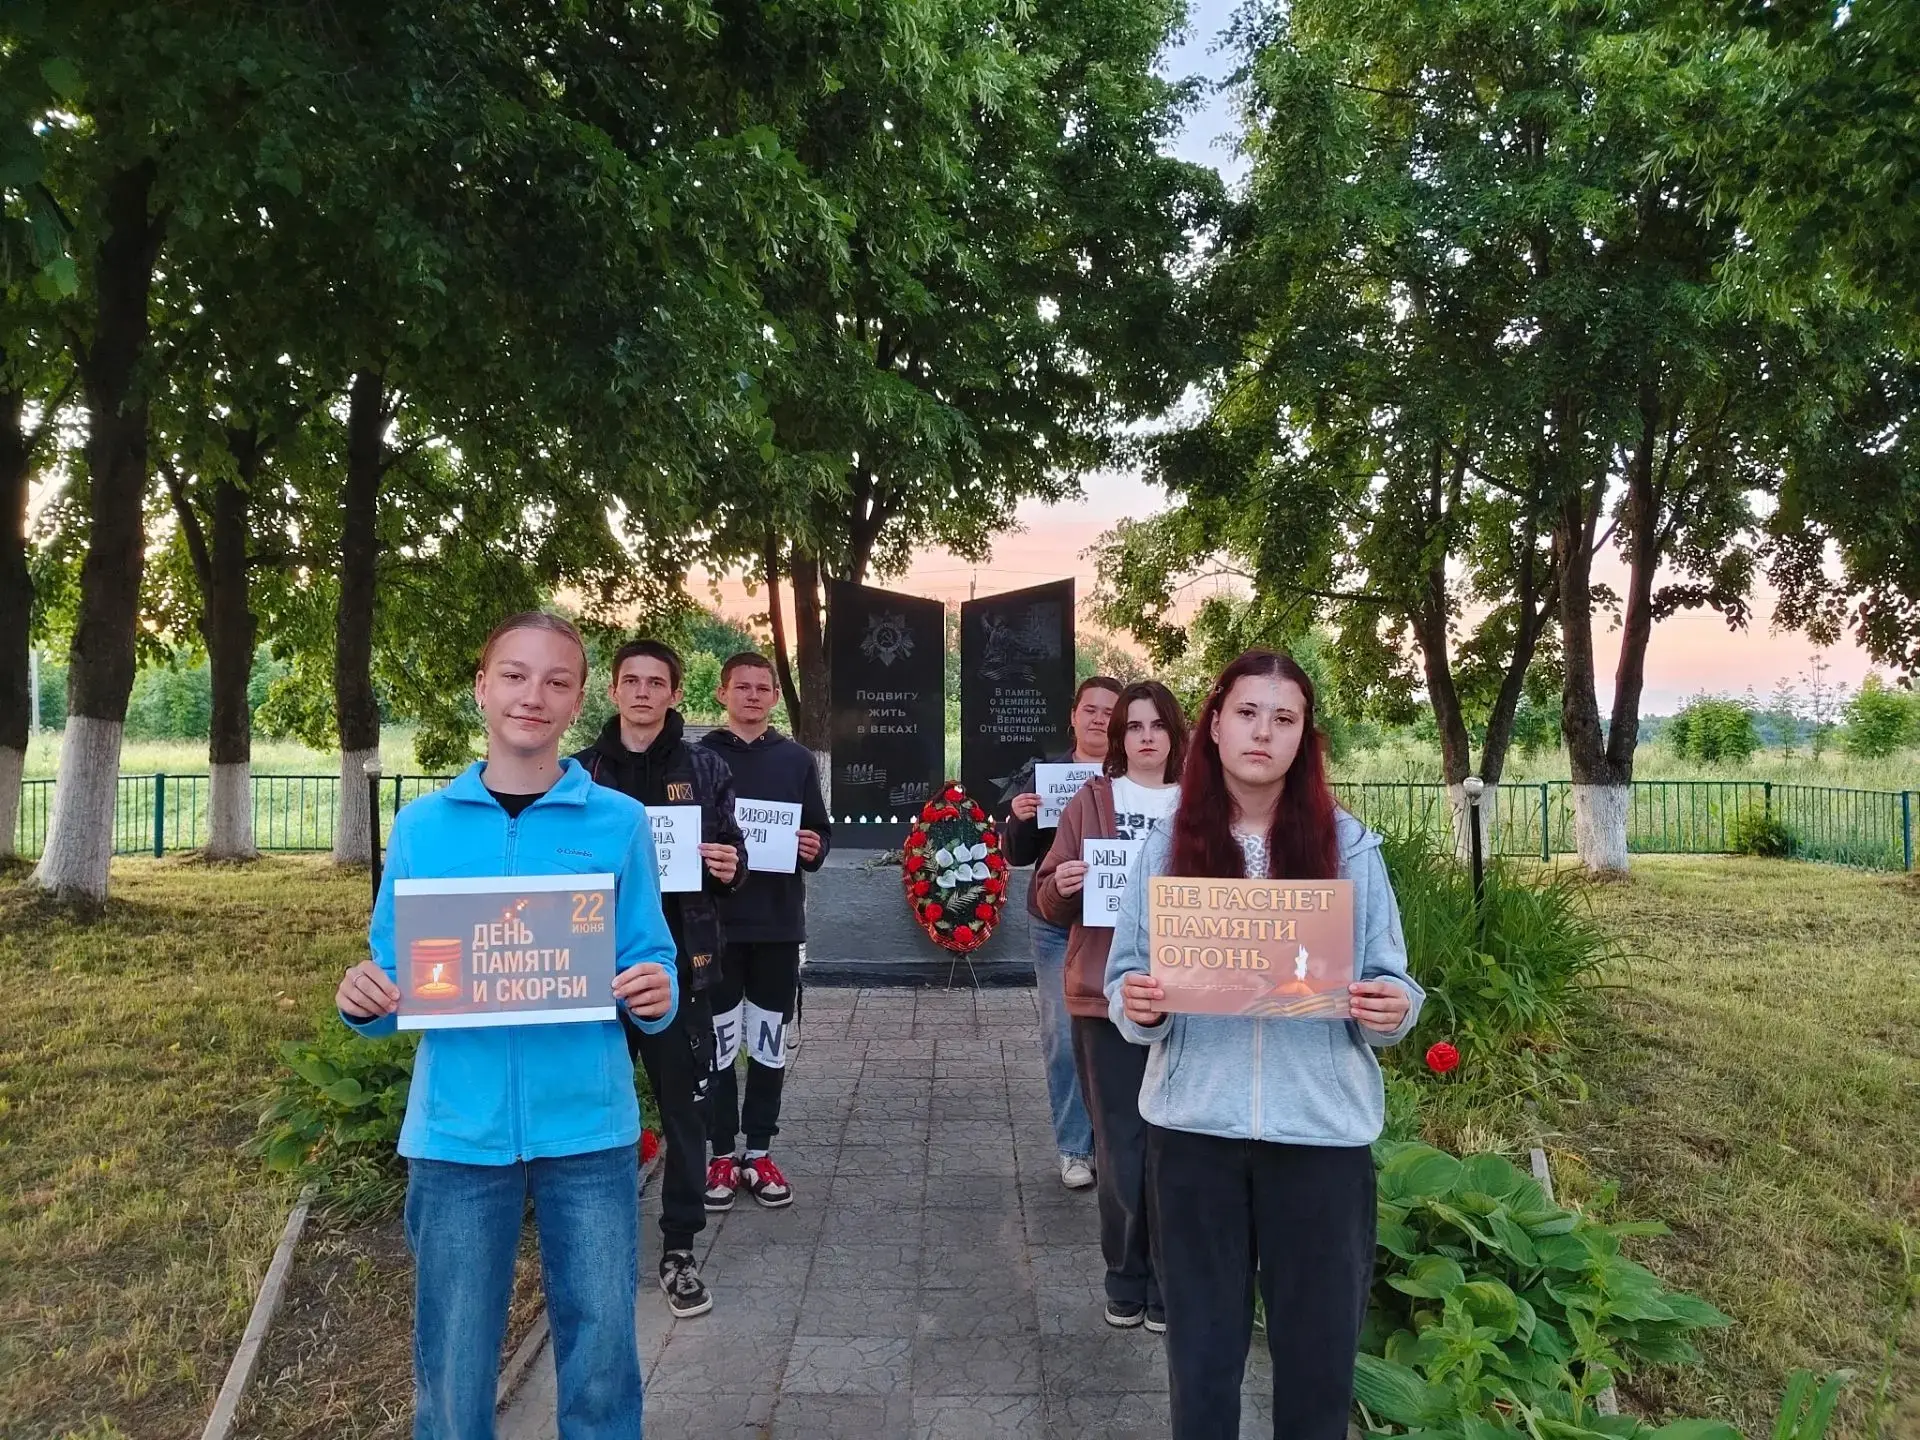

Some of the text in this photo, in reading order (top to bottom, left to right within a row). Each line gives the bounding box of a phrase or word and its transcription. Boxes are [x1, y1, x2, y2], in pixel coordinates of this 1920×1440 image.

[995, 688, 1003, 696] В
[739, 807, 794, 826] ИЮНЯ
[1092, 849, 1127, 867] МЫ
[571, 893, 605, 923] 22
[1156, 884, 1335, 912] НЕ ГАСНЕТ
[472, 922, 534, 951] ДЕНЬ
[571, 922, 605, 935] ИЮНЯ
[1156, 914, 1297, 941] ПАМЯТИ
[472, 948, 570, 975] ПАМЯТИ
[1157, 944, 1271, 971] ОГОНЬ
[472, 975, 588, 1003] И СКОРБИ
